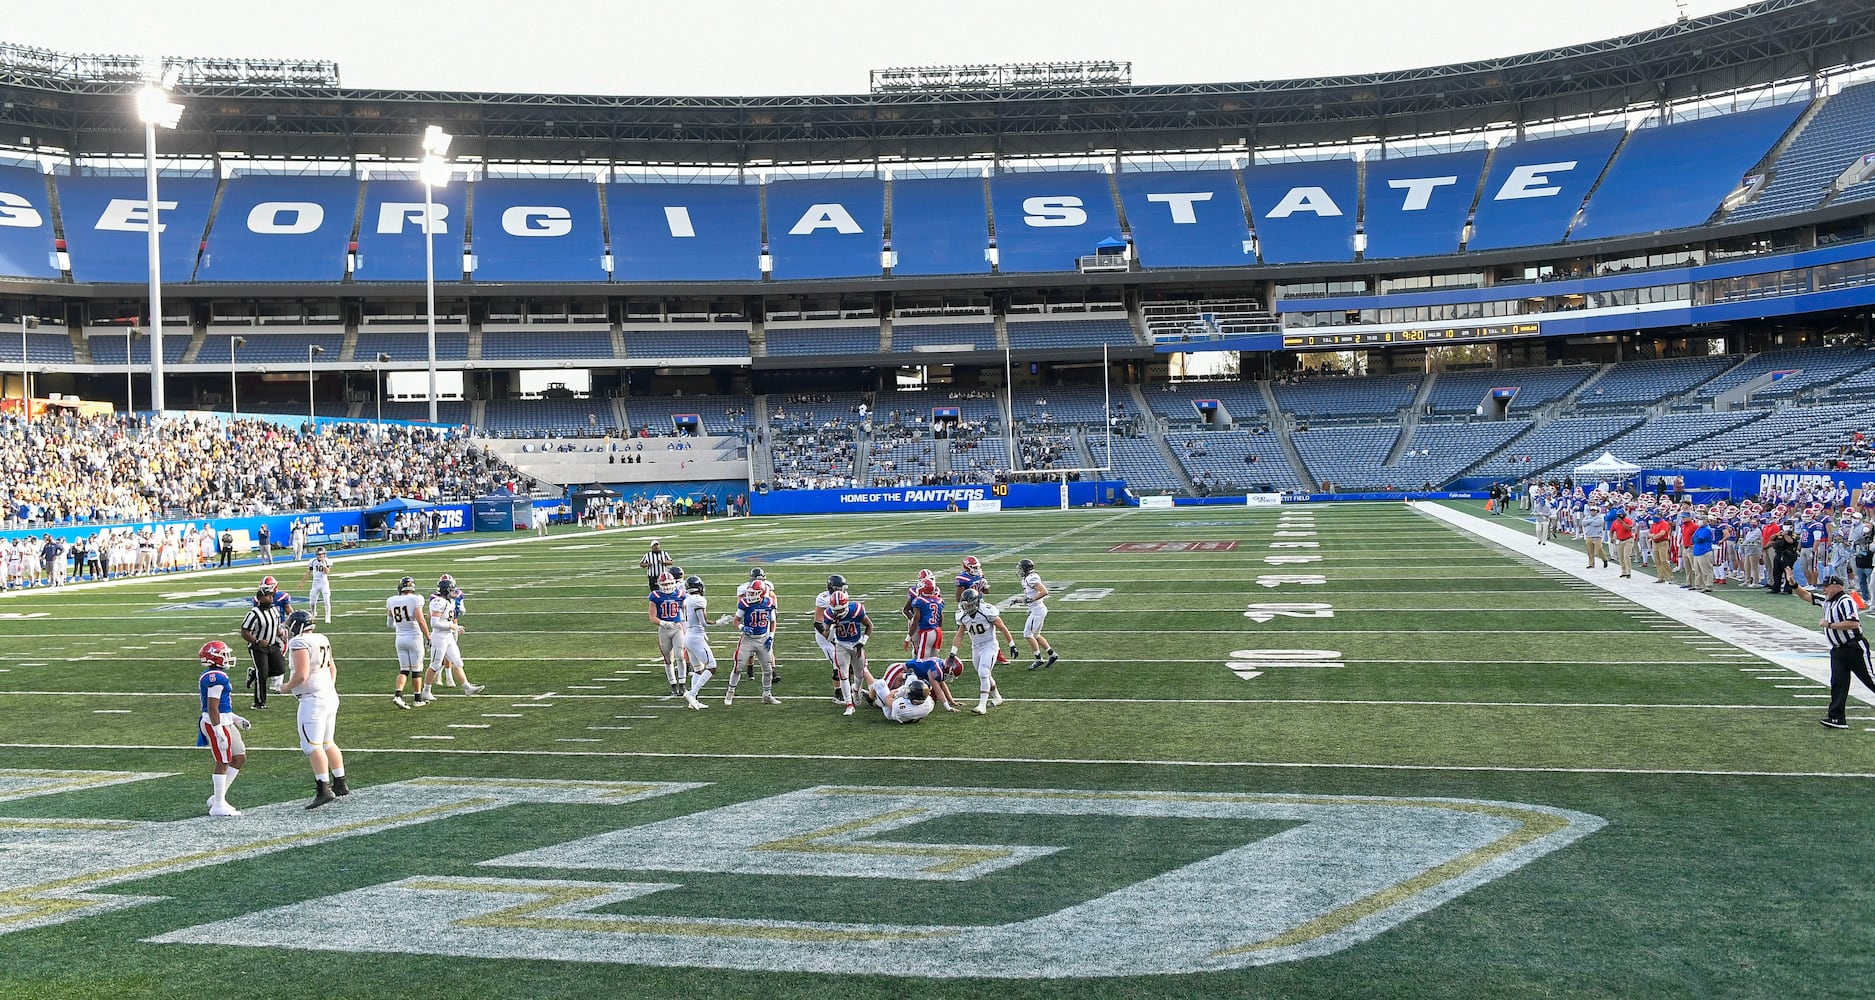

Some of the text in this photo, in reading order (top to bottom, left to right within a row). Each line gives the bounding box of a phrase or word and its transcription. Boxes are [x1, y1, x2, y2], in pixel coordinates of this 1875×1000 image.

[1023, 160, 1577, 228] STATE
[1355, 334, 1361, 343] 2
[1385, 333, 1391, 341] 8
[1402, 330, 1424, 340] 9:20
[1445, 329, 1454, 338] 10
[1512, 325, 1519, 334] 0
[840, 488, 984, 503] HOME OF THE PANTHERS
[992, 484, 1007, 496] 40
[303, 515, 321, 523] center
[393, 605, 411, 623] 81
[749, 611, 769, 627] 15
[929, 602, 939, 624] 3
[968, 623, 986, 636] 40
[1225, 649, 1345, 668] 10
